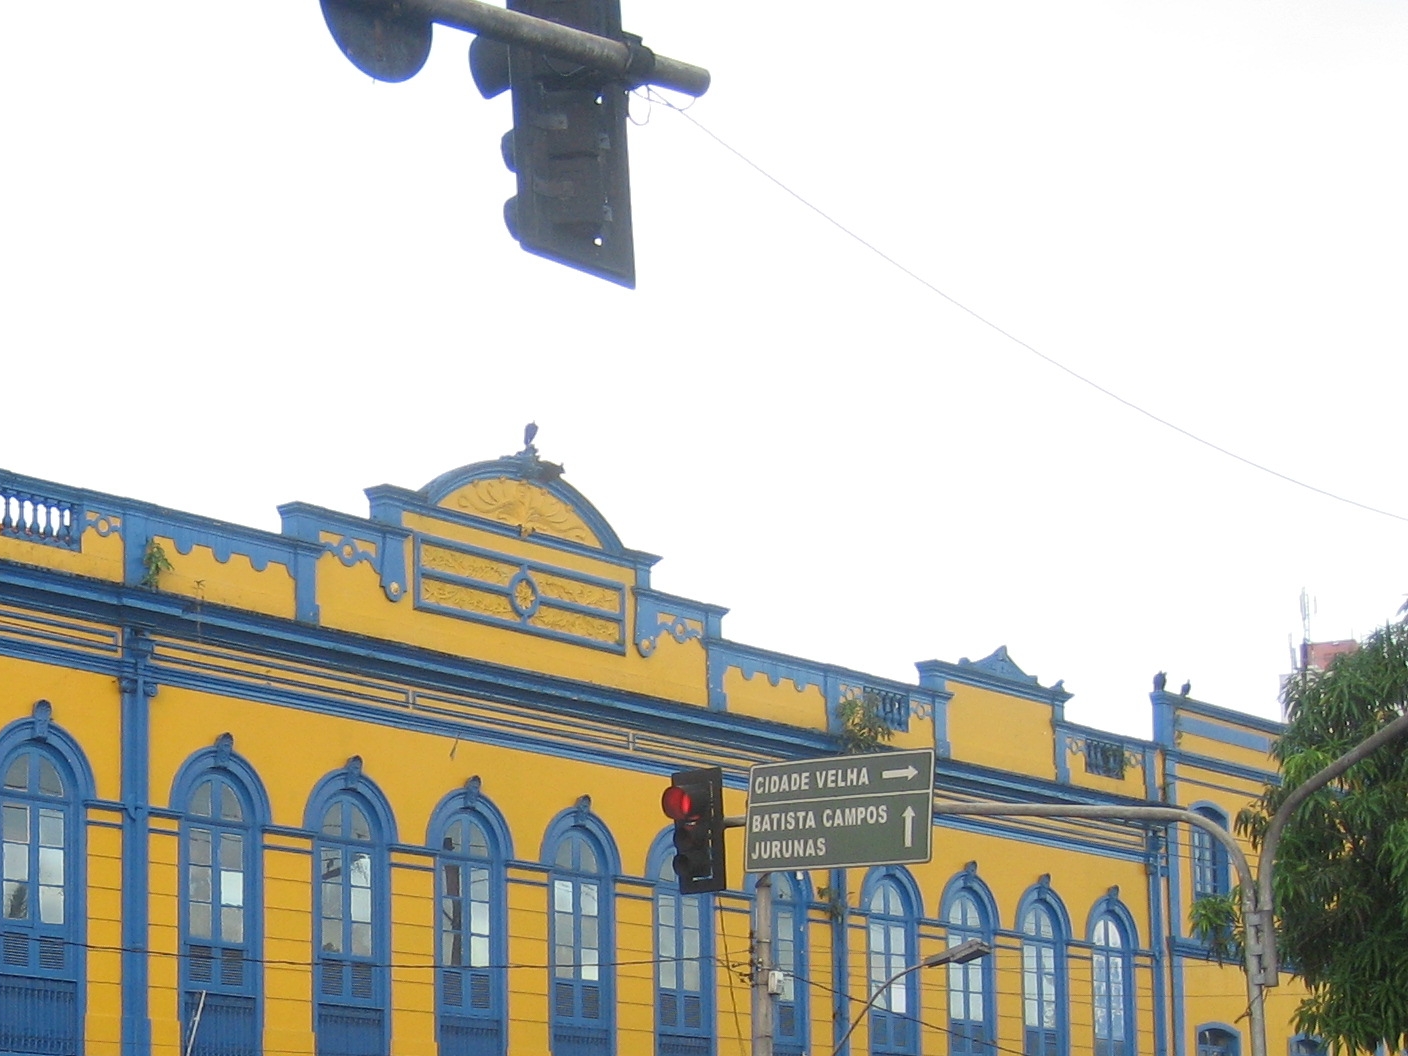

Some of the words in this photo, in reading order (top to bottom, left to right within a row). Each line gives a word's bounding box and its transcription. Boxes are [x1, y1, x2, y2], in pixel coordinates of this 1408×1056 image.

[754, 772, 810, 794] CIDADE
[815, 767, 870, 789] VELHA
[751, 810, 816, 833] BATISTA
[822, 804, 888, 828] CAMPOS
[750, 837, 827, 860] JURUNAS
